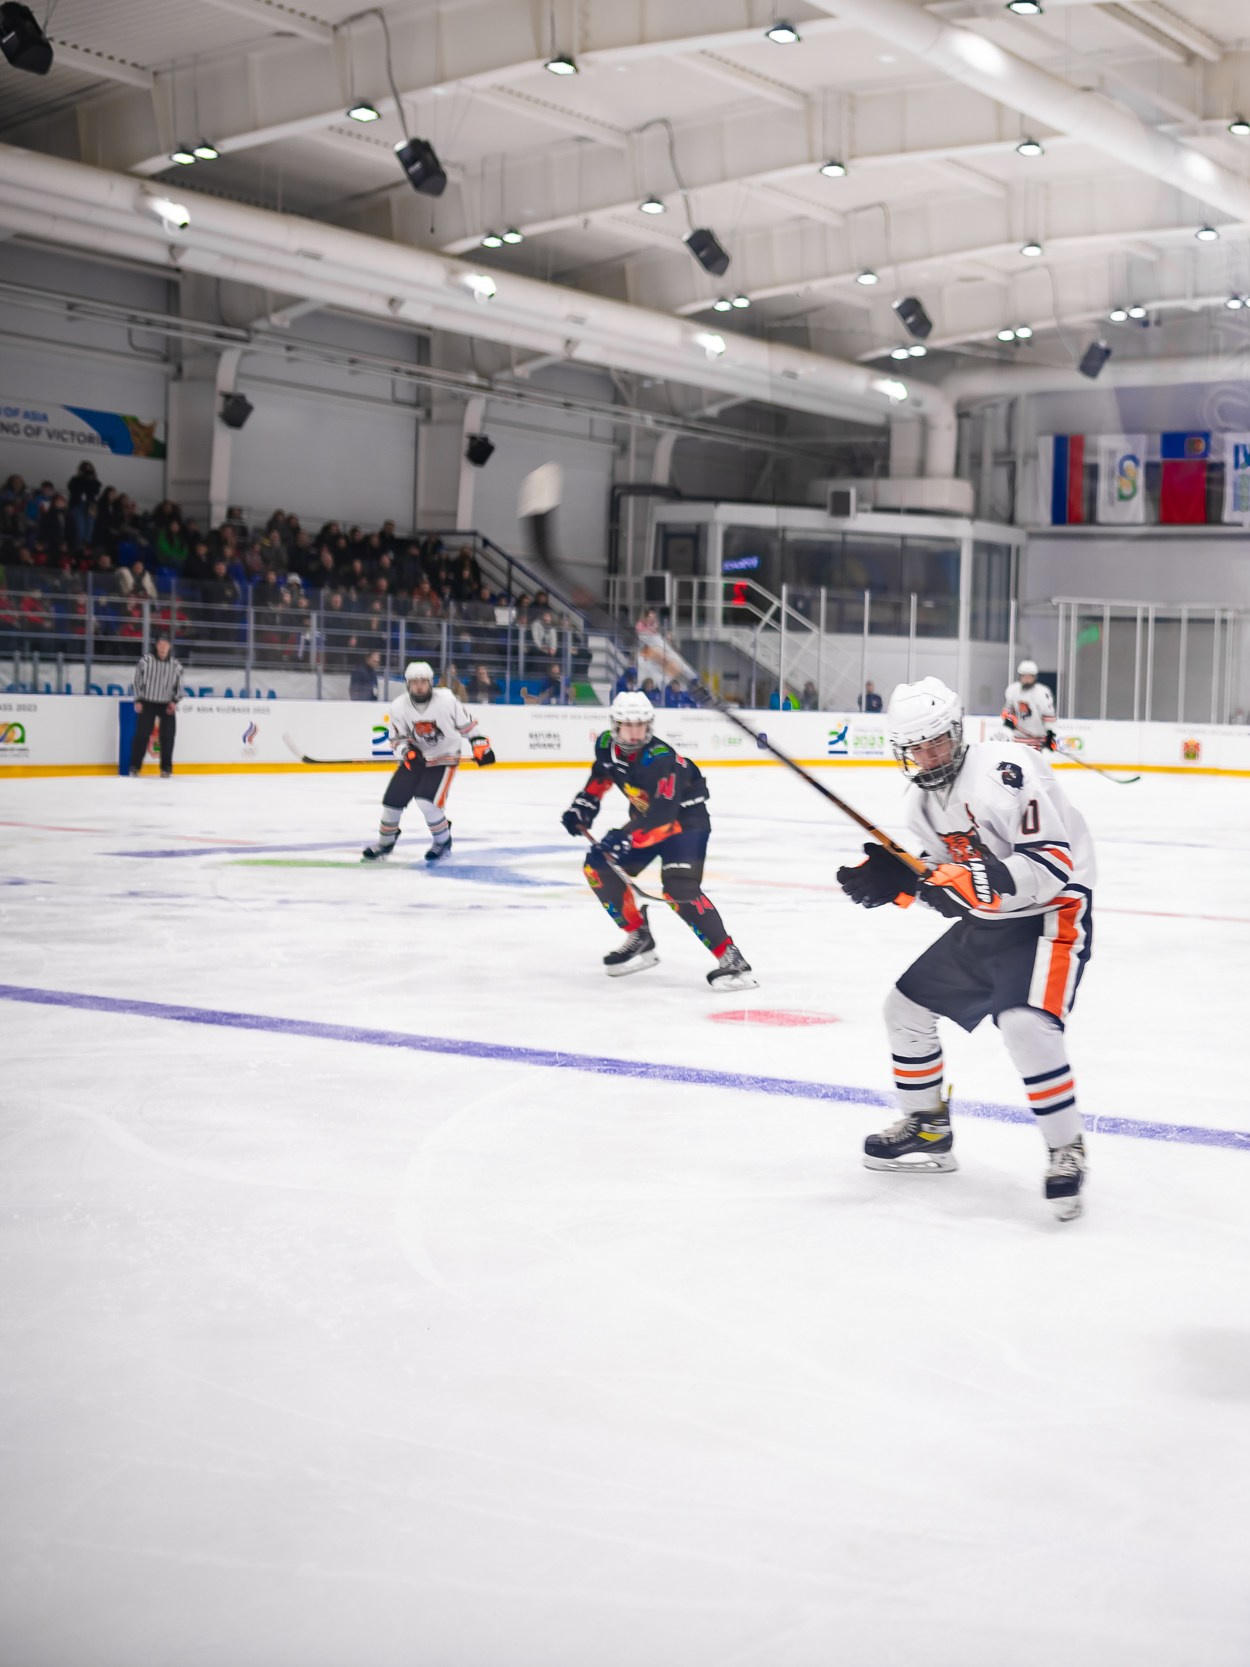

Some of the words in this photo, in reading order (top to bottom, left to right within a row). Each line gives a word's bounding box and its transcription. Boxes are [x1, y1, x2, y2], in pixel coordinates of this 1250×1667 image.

[3, 406, 20, 418] OF
[23, 410, 49, 422] ASIA
[23, 425, 42, 438] OF
